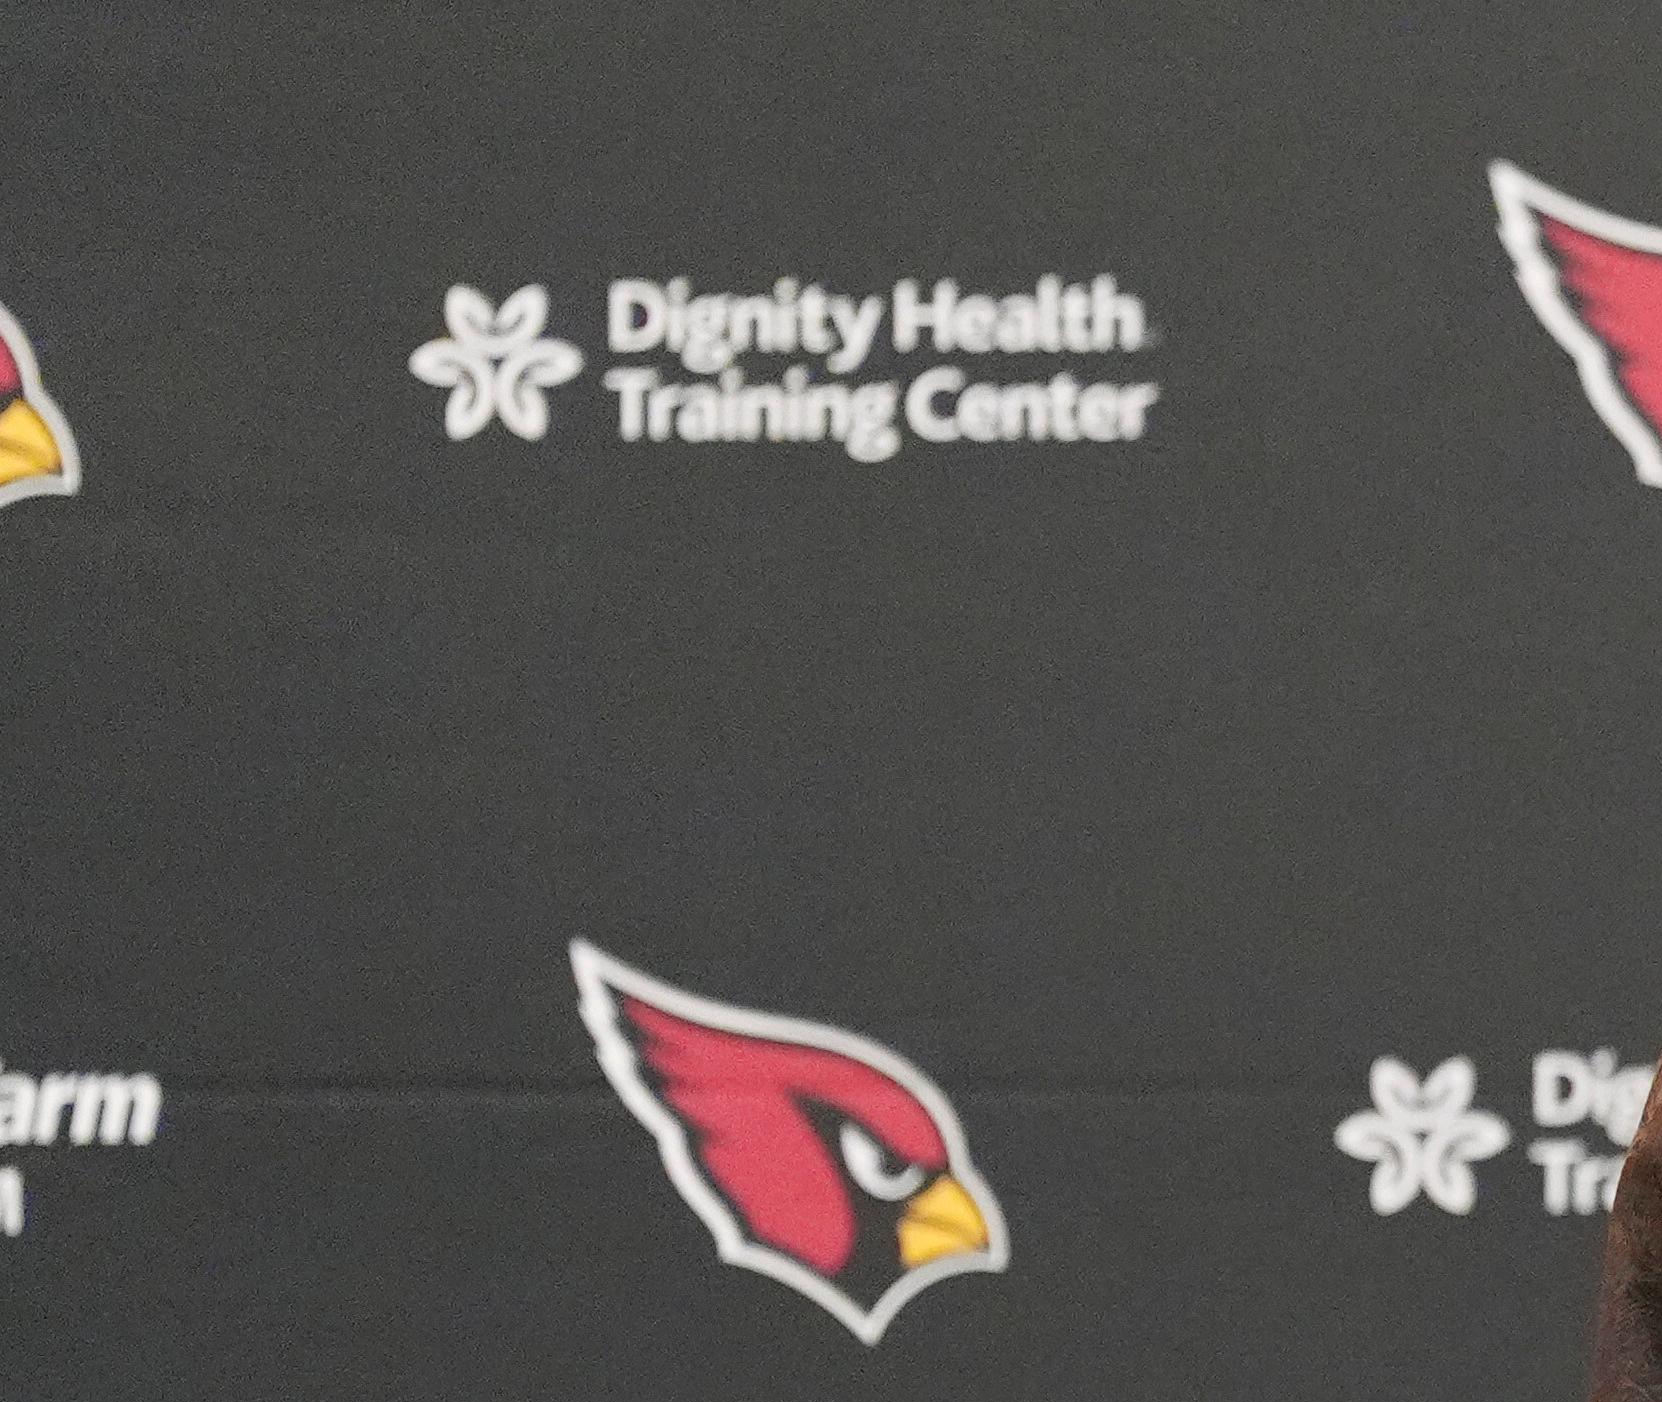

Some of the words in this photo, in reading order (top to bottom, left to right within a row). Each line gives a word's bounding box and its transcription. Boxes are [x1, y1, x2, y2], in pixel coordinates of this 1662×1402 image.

[605, 276, 884, 374] Dignity
[892, 272, 1151, 353] Health
[603, 367, 901, 463] Training
[905, 365, 1160, 442] Center
